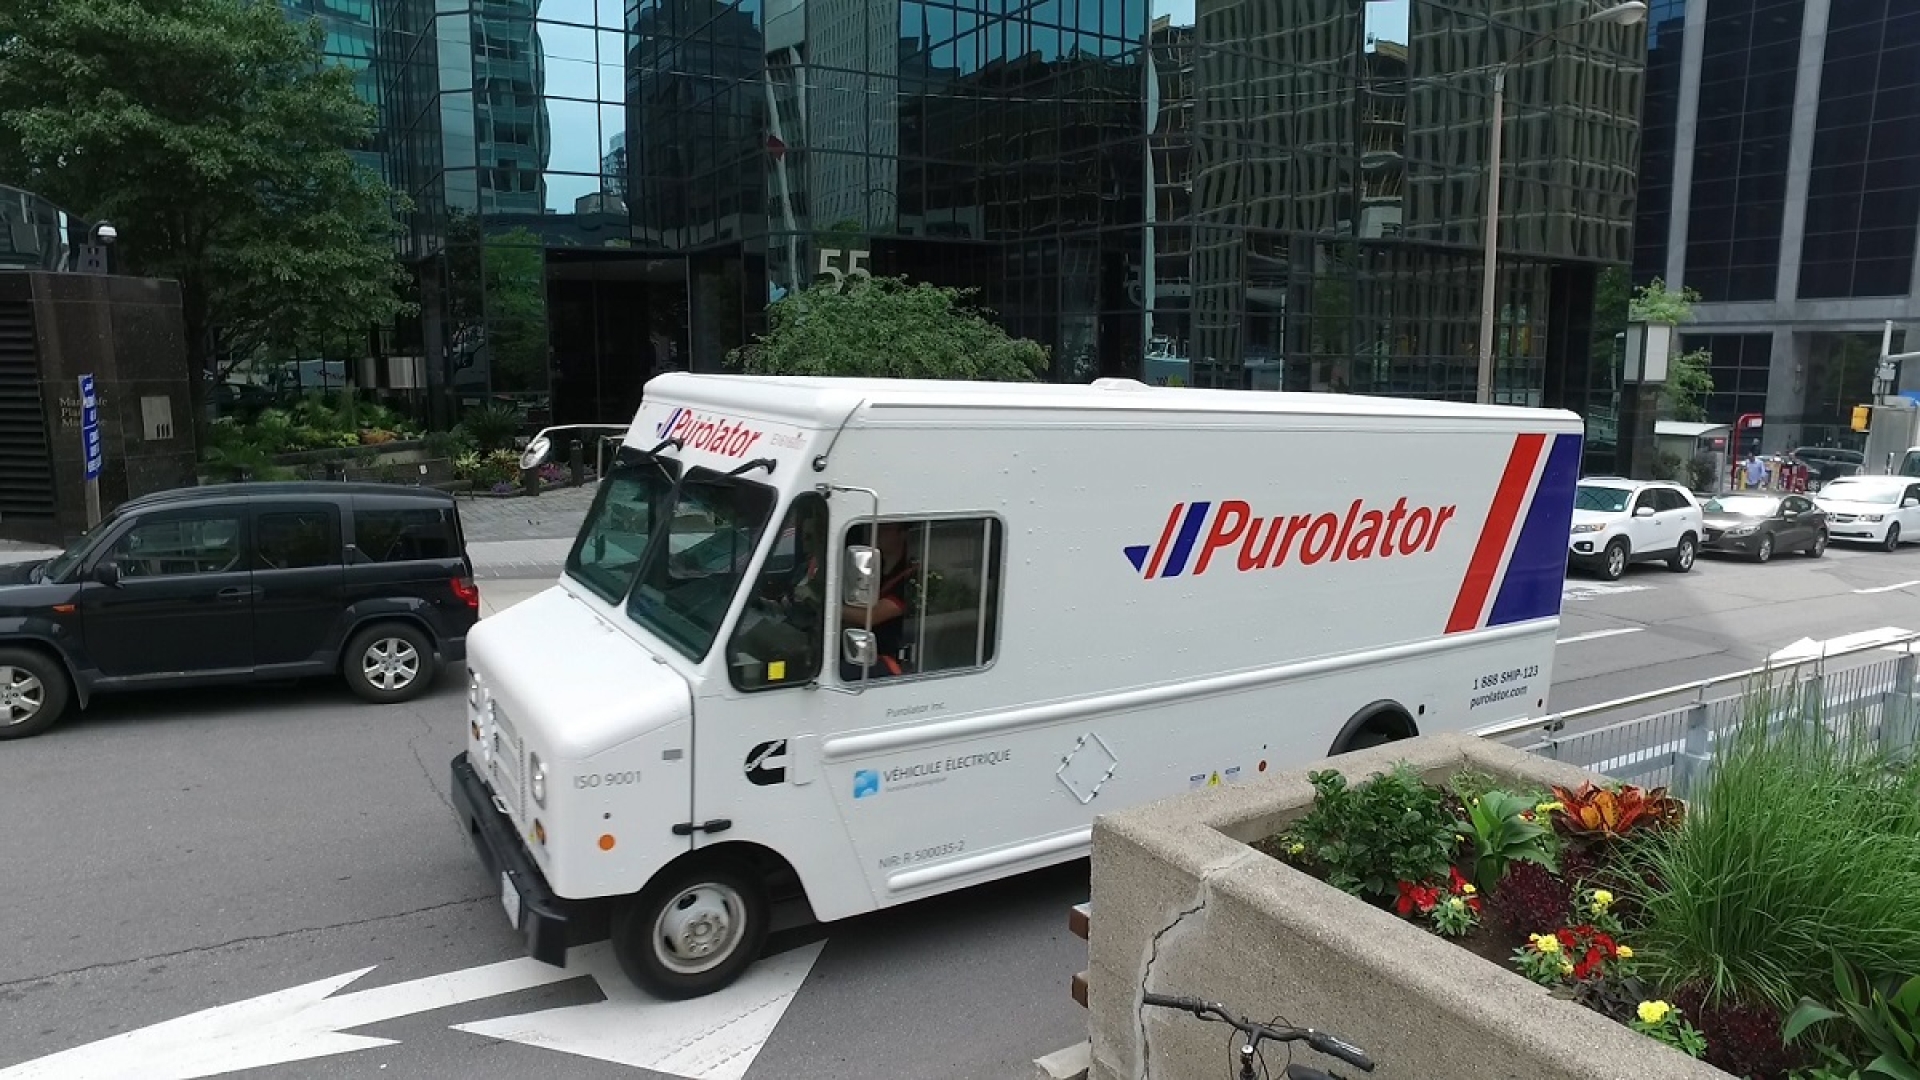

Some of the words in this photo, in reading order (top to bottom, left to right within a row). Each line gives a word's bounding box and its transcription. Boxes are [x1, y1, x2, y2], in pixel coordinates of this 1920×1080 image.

[819, 248, 872, 292] 55
[671, 408, 764, 458] Purolator
[1192, 497, 1457, 575] Purolator
[1473, 678, 1478, 690] 1
[1481, 673, 1499, 689] 888
[886, 704, 929, 718] Purolator
[1469, 686, 1528, 710] purolator.com
[883, 760, 942, 782] VÉHICULE
[945, 748, 1012, 772] ÉLECTRIQUE
[573, 773, 602, 790] ISO
[604, 770, 642, 787] 9001
